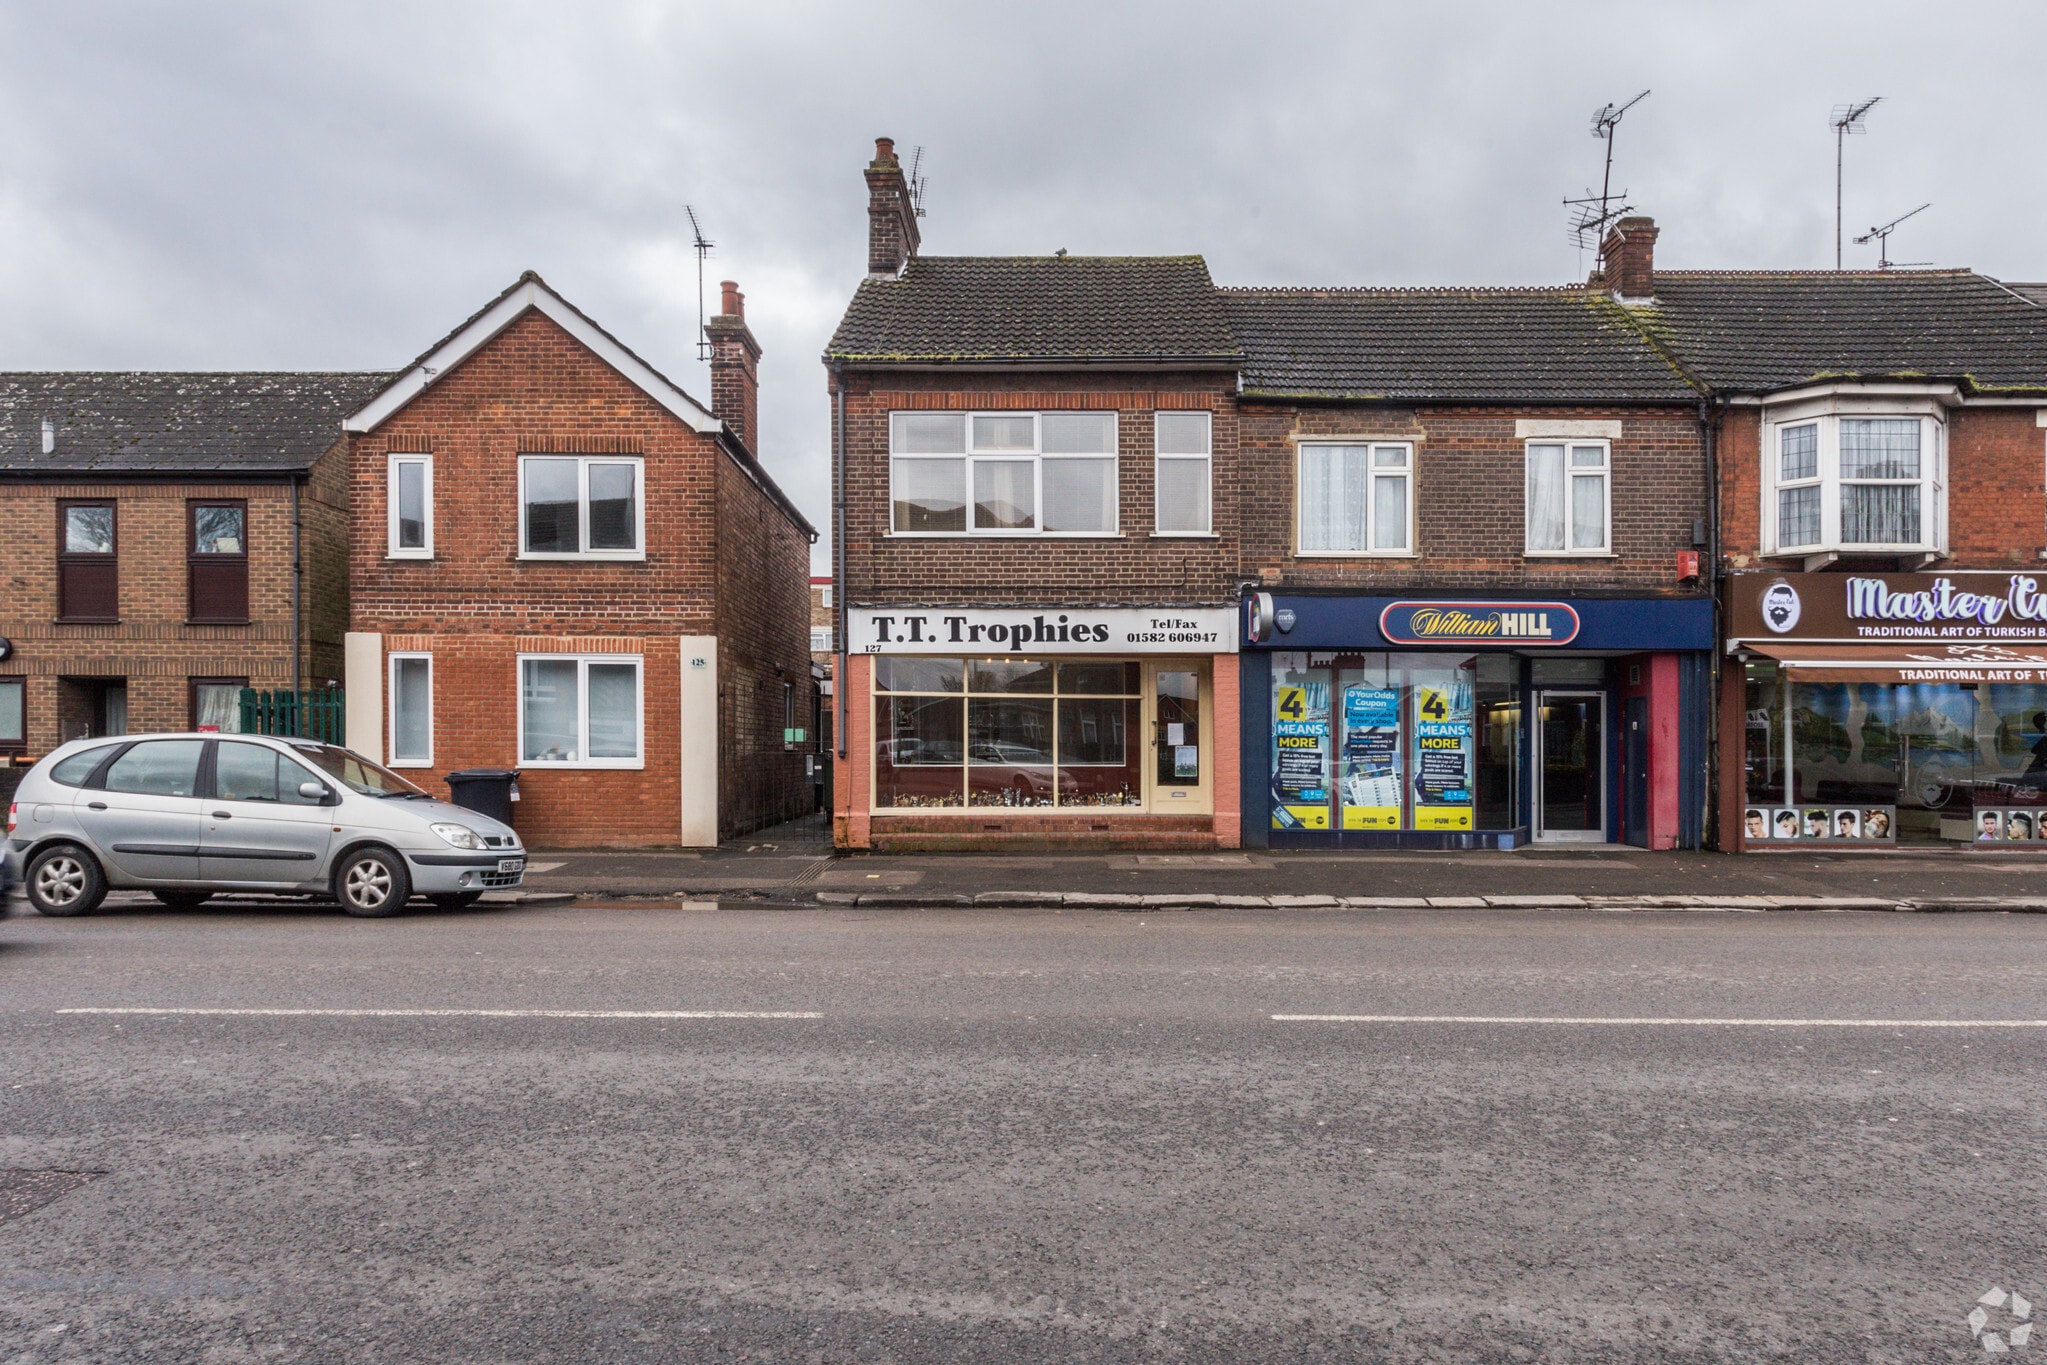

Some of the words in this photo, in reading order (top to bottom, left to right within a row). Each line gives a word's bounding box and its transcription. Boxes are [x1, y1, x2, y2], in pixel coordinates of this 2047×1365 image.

[1846, 576, 2008, 625] Master
[1150, 618, 1198, 629] Tel/Fax
[1410, 608, 1502, 637] William
[1501, 613, 1552, 636] HILL
[871, 616, 937, 643] T.T.
[943, 614, 1110, 651] Trophies
[1857, 626, 1938, 637] TRADITIONAL
[1940, 626, 1965, 637] ART
[1966, 626, 1983, 637] OF
[1985, 626, 2036, 637] TURKISH
[1127, 632, 1166, 643] 01582
[1169, 632, 1218, 643] 606947
[865, 645, 882, 653] 127
[692, 658, 705, 666] 125
[1899, 669, 1986, 680] TRADITIONAL
[1987, 670, 2011, 680] ART
[2014, 670, 2032, 681] OF
[1356, 690, 1395, 700] YourOdds
[1280, 690, 1303, 718] 4
[1355, 699, 1387, 708] Coupon
[1422, 691, 1446, 719] 4
[1277, 724, 1324, 735] MEANS
[1420, 725, 1466, 736] MEANS
[1279, 737, 1317, 748] MORE
[1421, 738, 1459, 749] MORE
